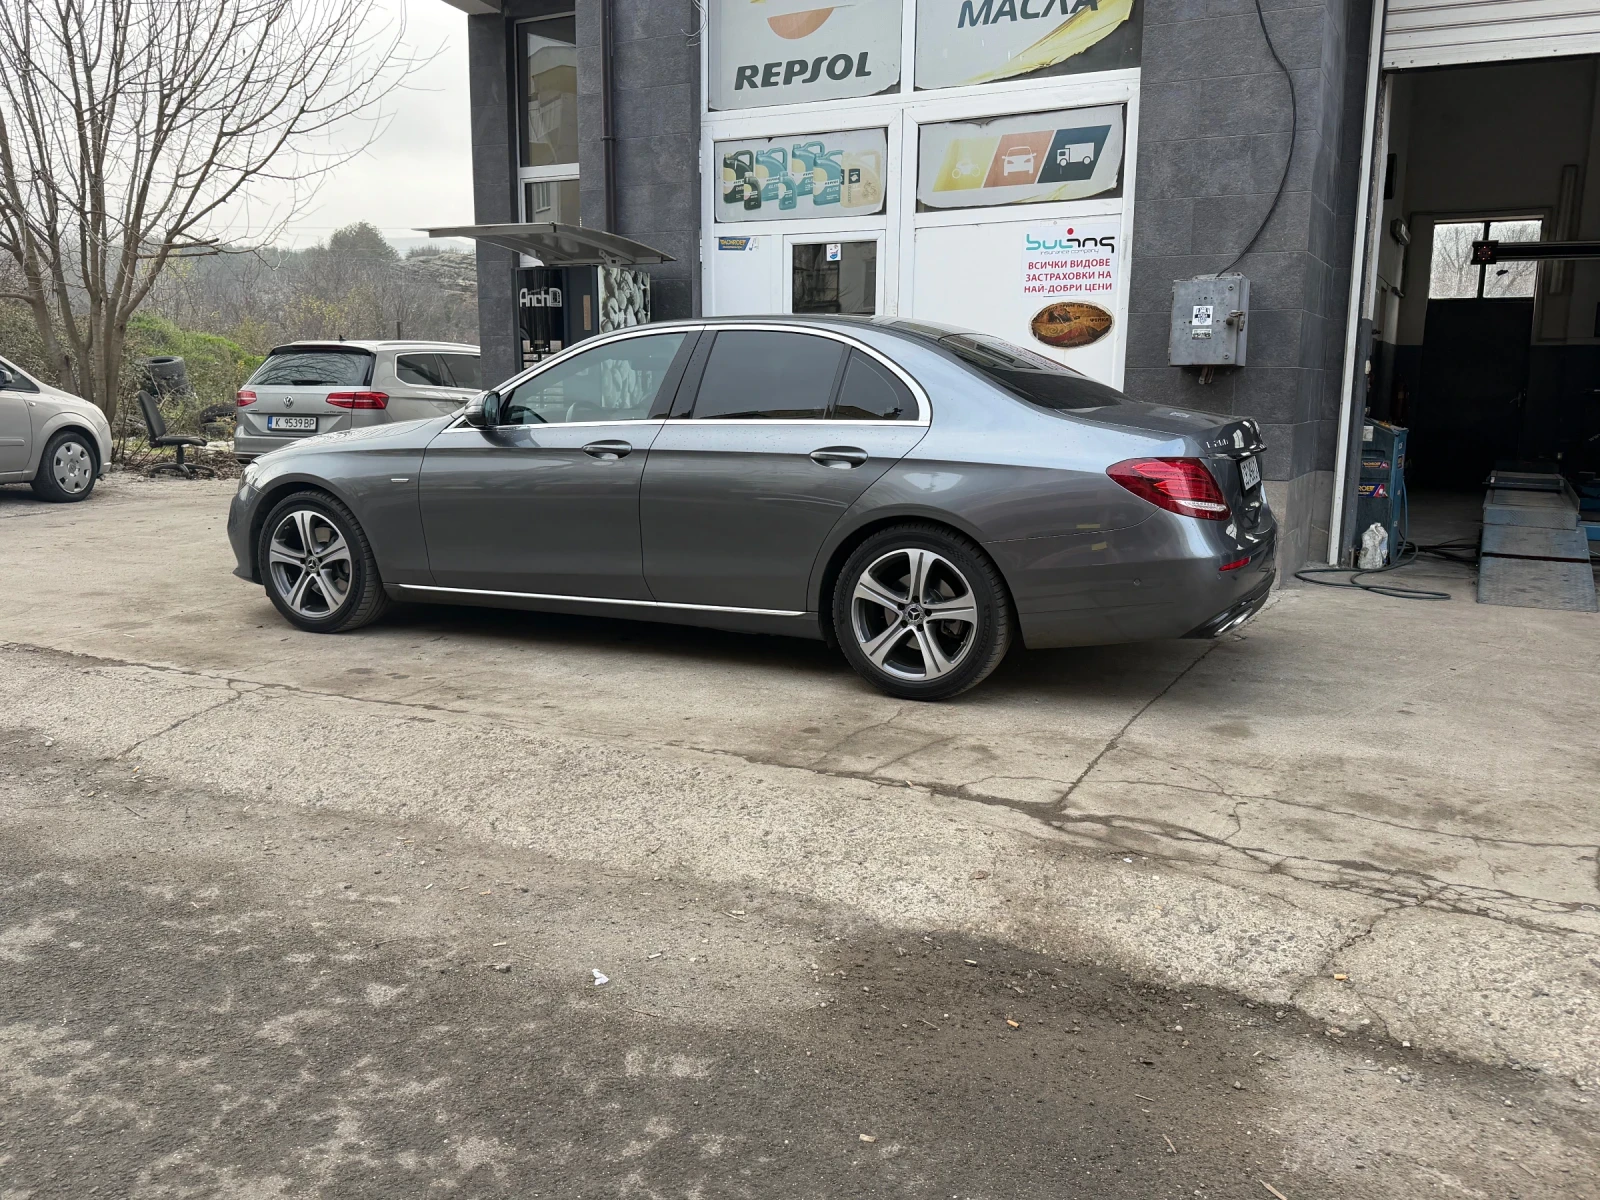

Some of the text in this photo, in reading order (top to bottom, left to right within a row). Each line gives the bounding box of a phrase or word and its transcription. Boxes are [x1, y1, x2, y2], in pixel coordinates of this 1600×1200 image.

[734, 51, 872, 91] REPSOL
[1028, 258, 1111, 270] ВСИЧКИ ВИДОВЕ
[1025, 270, 1112, 282] ЗАСТРАХОВКИ НА
[1024, 282, 1113, 294] НАЙ-ДОБРИ ЦЕНИ
[275, 417, 315, 428] K 9539 BP
